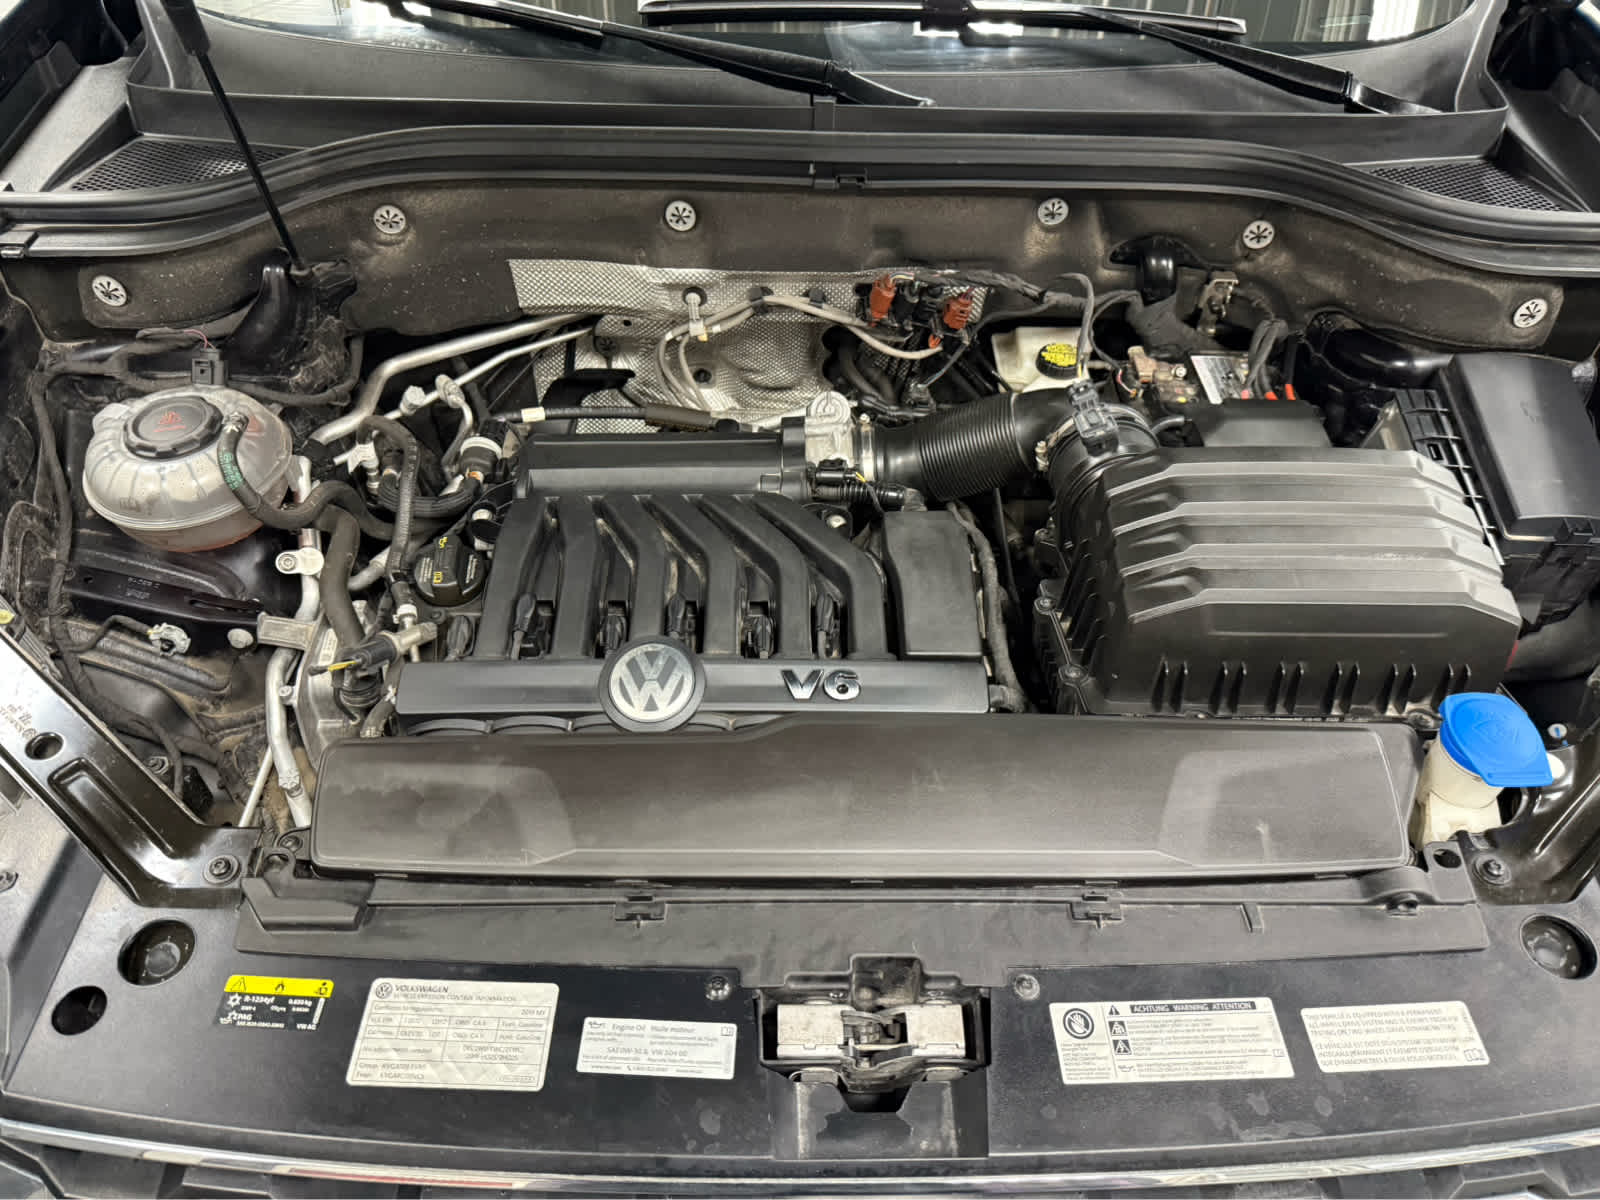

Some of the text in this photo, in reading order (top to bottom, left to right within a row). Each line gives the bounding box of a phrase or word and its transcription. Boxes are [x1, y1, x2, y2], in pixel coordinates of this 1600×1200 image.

[609, 643, 695, 722] VW
[781, 669, 862, 701] V6
[395, 984, 449, 993] VOLKSWAGEN
[1133, 1001, 1252, 1012] ACHTUNG WARNING ATTENTION
[612, 1023, 635, 1032] Engine
